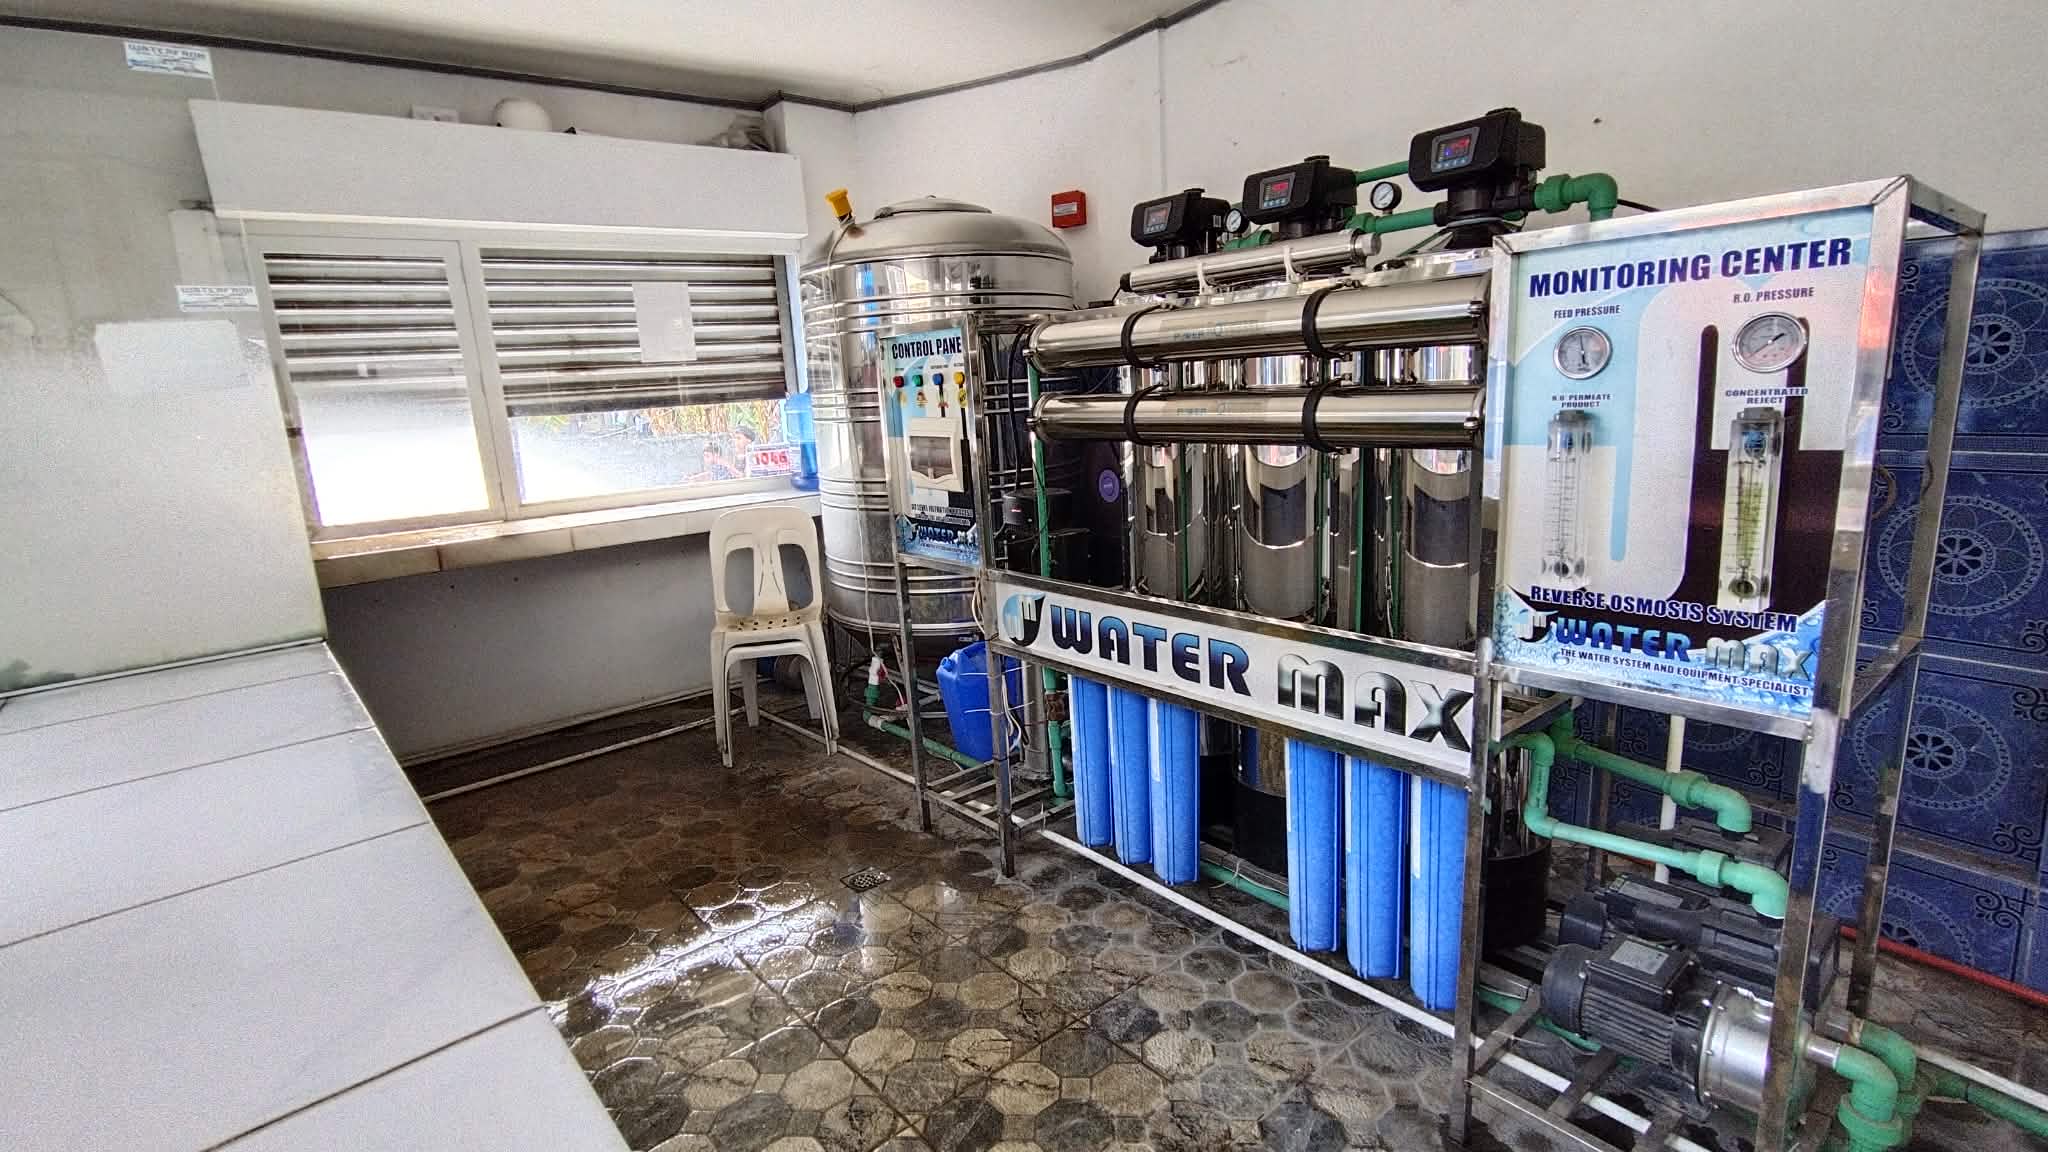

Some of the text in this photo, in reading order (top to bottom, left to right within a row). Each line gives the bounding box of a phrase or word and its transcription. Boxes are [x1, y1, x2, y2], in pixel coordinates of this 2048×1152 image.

[1529, 237, 1852, 298] MONITORING CENTER
[1756, 287, 1815, 302] PRESSURE
[1553, 304, 1621, 319] FEED PRESSURE
[892, 336, 962, 360] CONTROL PANE
[1568, 393, 1611, 401] PERMEATE
[1725, 388, 1808, 397] CONCENTRATED
[1747, 396, 1785, 404] REJECT
[1531, 585, 1797, 632] REVERSE OSMOSIS SYSTEM
[1556, 616, 1814, 682] WATER MAX
[1050, 604, 1474, 752] WATER MAX
[1561, 648, 1809, 696] THE WATER SYSTEM AND EQUIPMENT SPECIALIST
